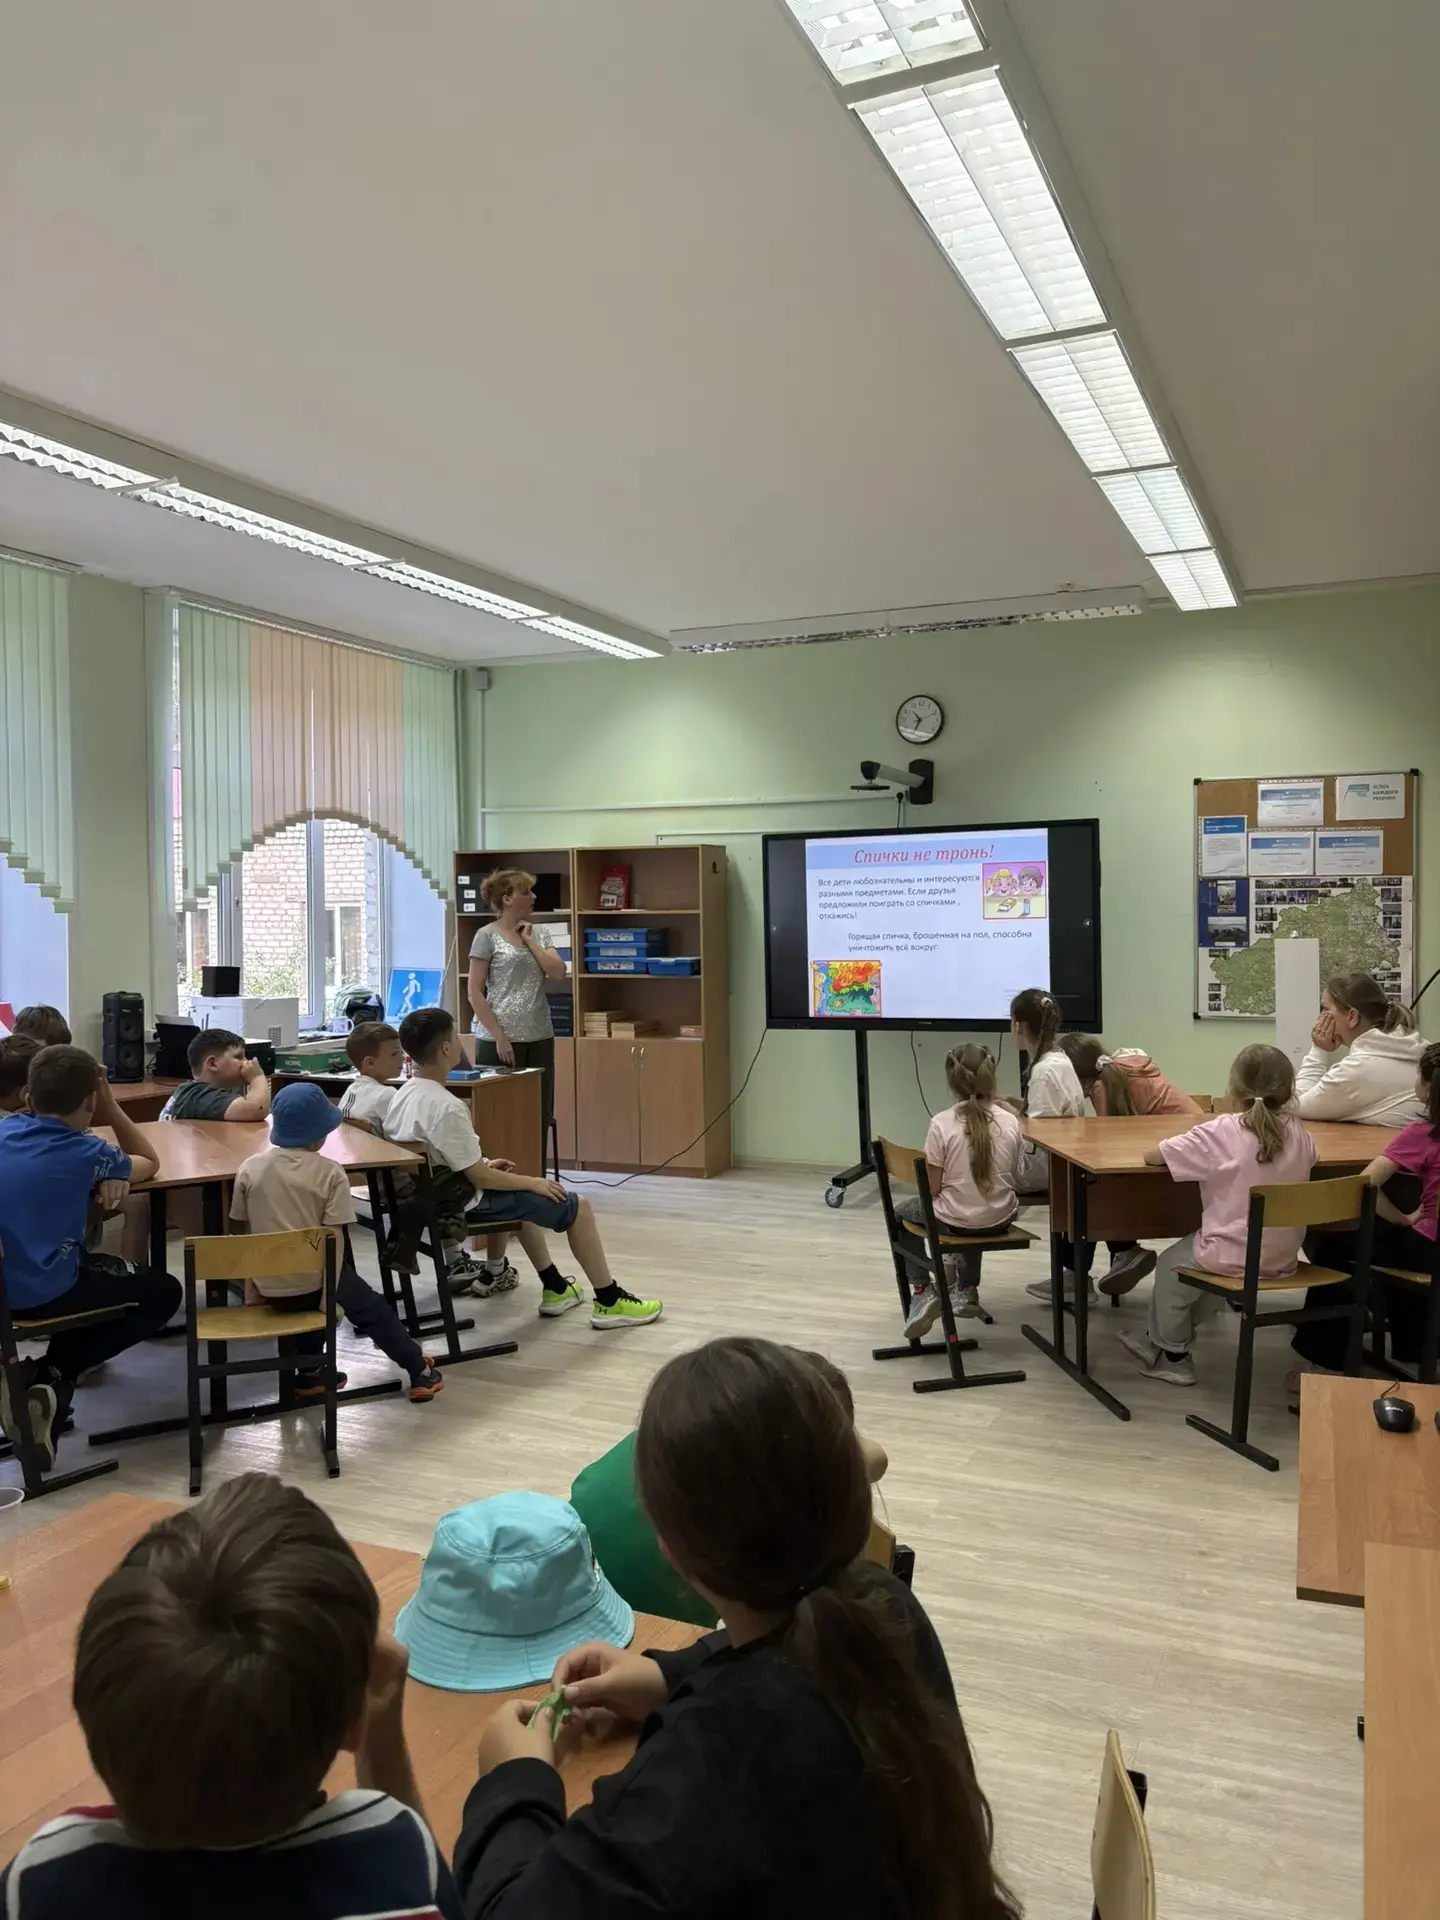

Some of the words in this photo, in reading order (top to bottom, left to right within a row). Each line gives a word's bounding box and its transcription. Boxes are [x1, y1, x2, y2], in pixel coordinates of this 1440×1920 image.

[854, 849, 909, 864] Спички
[913, 850, 932, 861] не
[935, 844, 995, 863] тронь!
[818, 878, 832, 887] Все
[833, 879, 852, 887] дети
[852, 876, 915, 886] любознательны
[924, 875, 980, 884] интересуются
[818, 890, 854, 899] разными
[855, 888, 906, 897] предметами.
[907, 887, 926, 896] Если
[928, 887, 956, 896] друзья
[818, 901, 868, 910] предложили
[868, 900, 904, 909] поиграть
[916, 899, 956, 908] спичками
[818, 911, 858, 920] откажись!
[848, 932, 881, 941] Горящая
[882, 932, 911, 941] спичка,
[912, 931, 959, 941] брошенная
[972, 931, 991, 940] пол,
[992, 929, 1033, 939] способна
[848, 944, 894, 953] уничтожить
[910, 943, 939, 952] вокруг.
